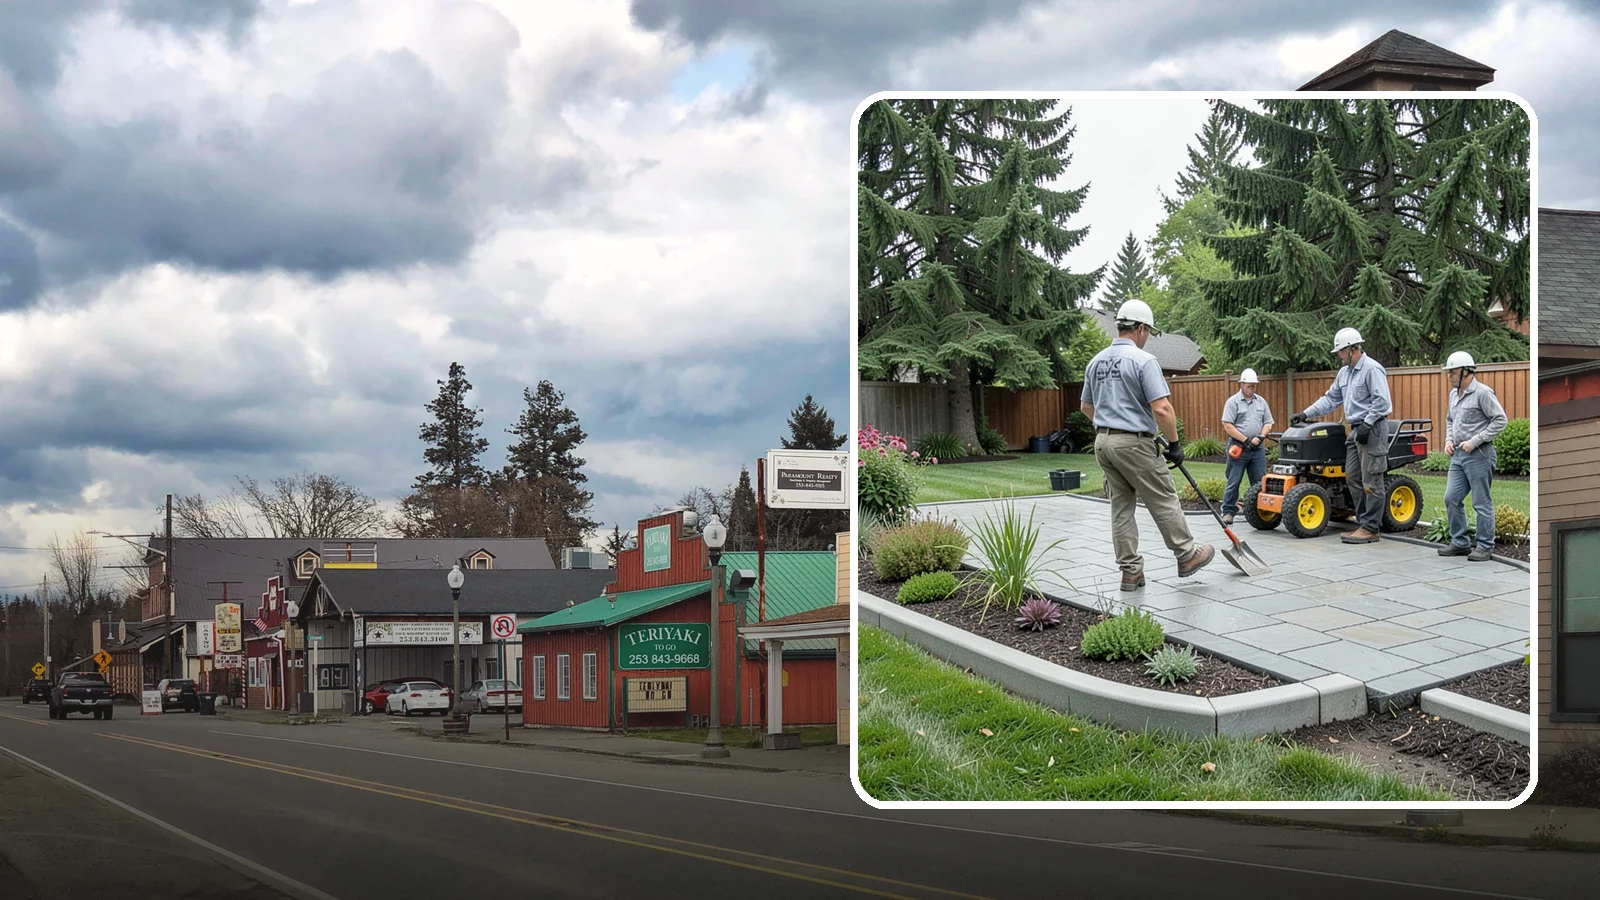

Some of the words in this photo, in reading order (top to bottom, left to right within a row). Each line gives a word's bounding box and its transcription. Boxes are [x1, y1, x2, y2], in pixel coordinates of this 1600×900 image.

[781, 471, 815, 479] PARAMOUNT
[817, 472, 839, 480] REALTY
[625, 627, 702, 646] TERIYAKI
[628, 654, 648, 664] 253
[651, 653, 700, 664] 843-9668
